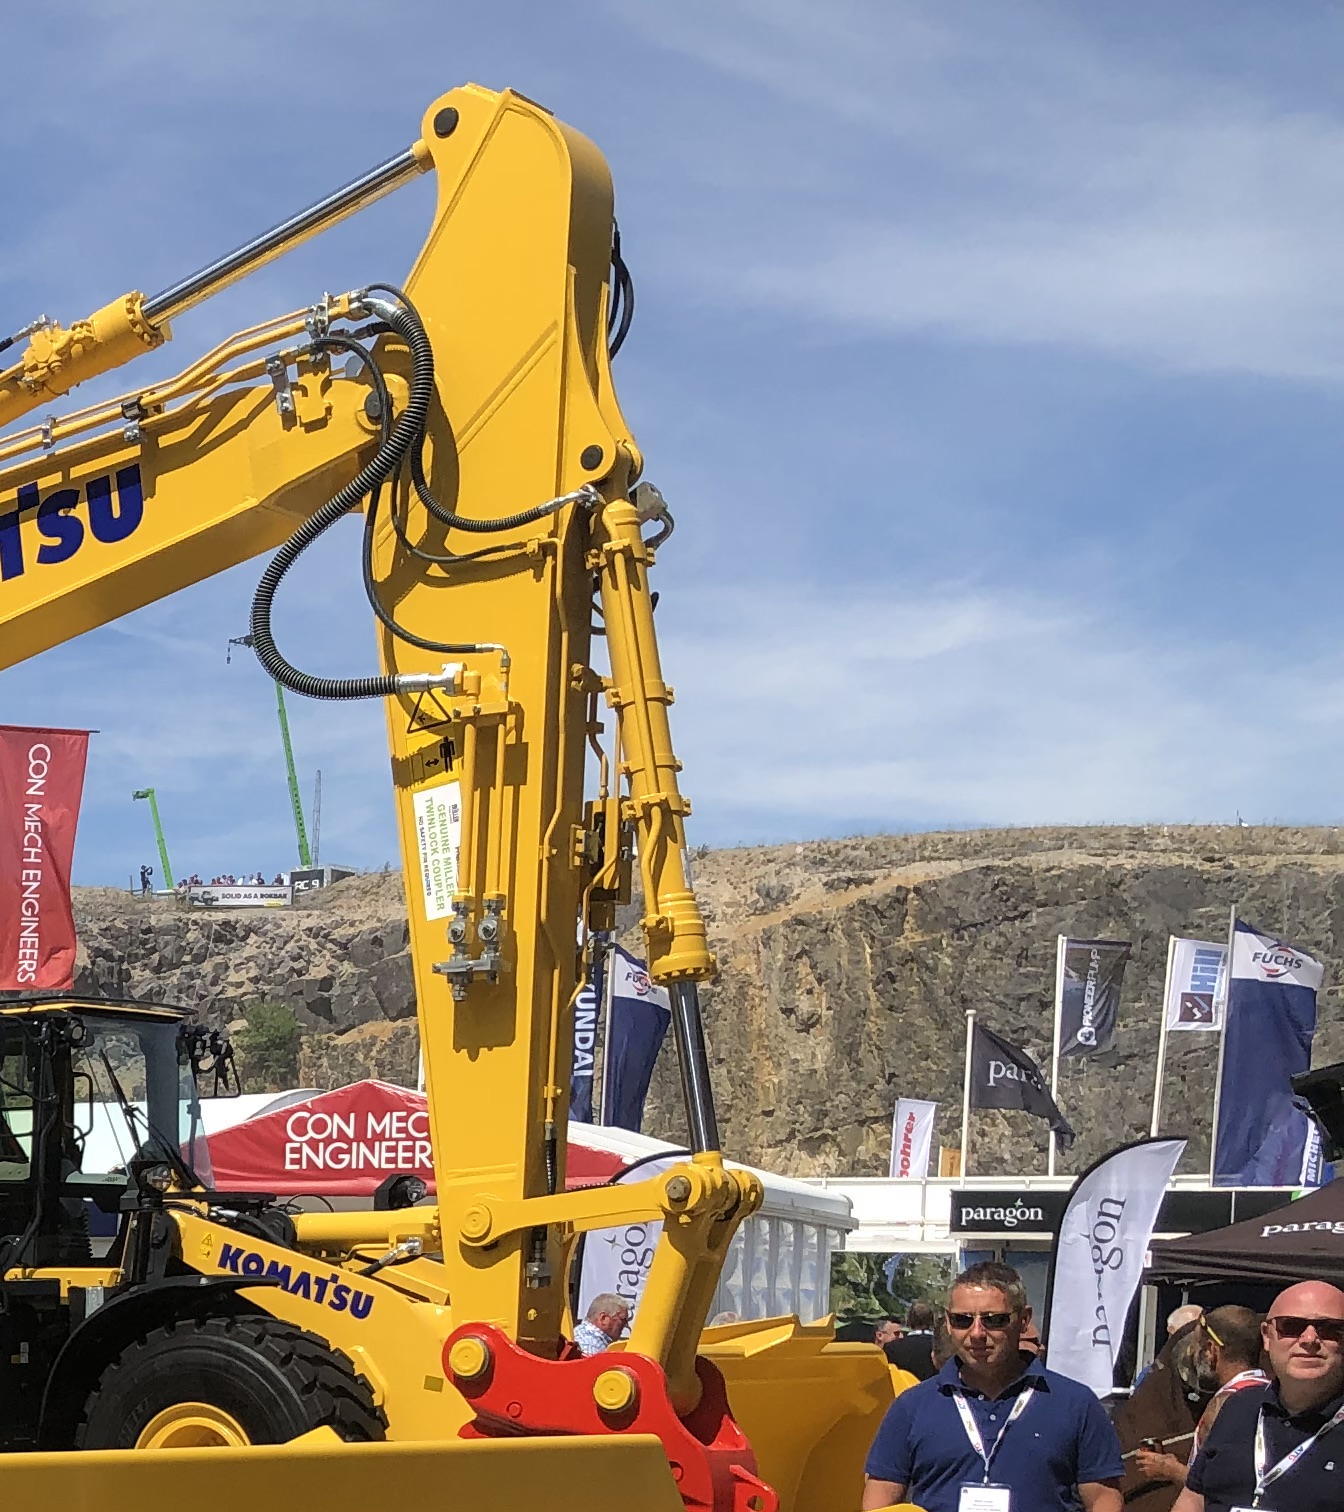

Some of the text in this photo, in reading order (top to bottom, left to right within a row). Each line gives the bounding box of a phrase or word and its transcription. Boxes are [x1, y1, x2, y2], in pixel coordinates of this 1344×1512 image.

[16, 743, 51, 984] CON MECH ENGINEERS
[425, 797, 445, 911] TWINLOCK COUPLER
[437, 804, 455, 898] GENUINE MILLER
[1252, 951, 1304, 969] FUCHS
[574, 984, 597, 1077] UNDAI
[285, 1130, 435, 1169] ENGINEER
[286, 1111, 430, 1142] CON MEC
[961, 1205, 1043, 1227] paragon
[217, 1243, 375, 1319] KOMATSU
